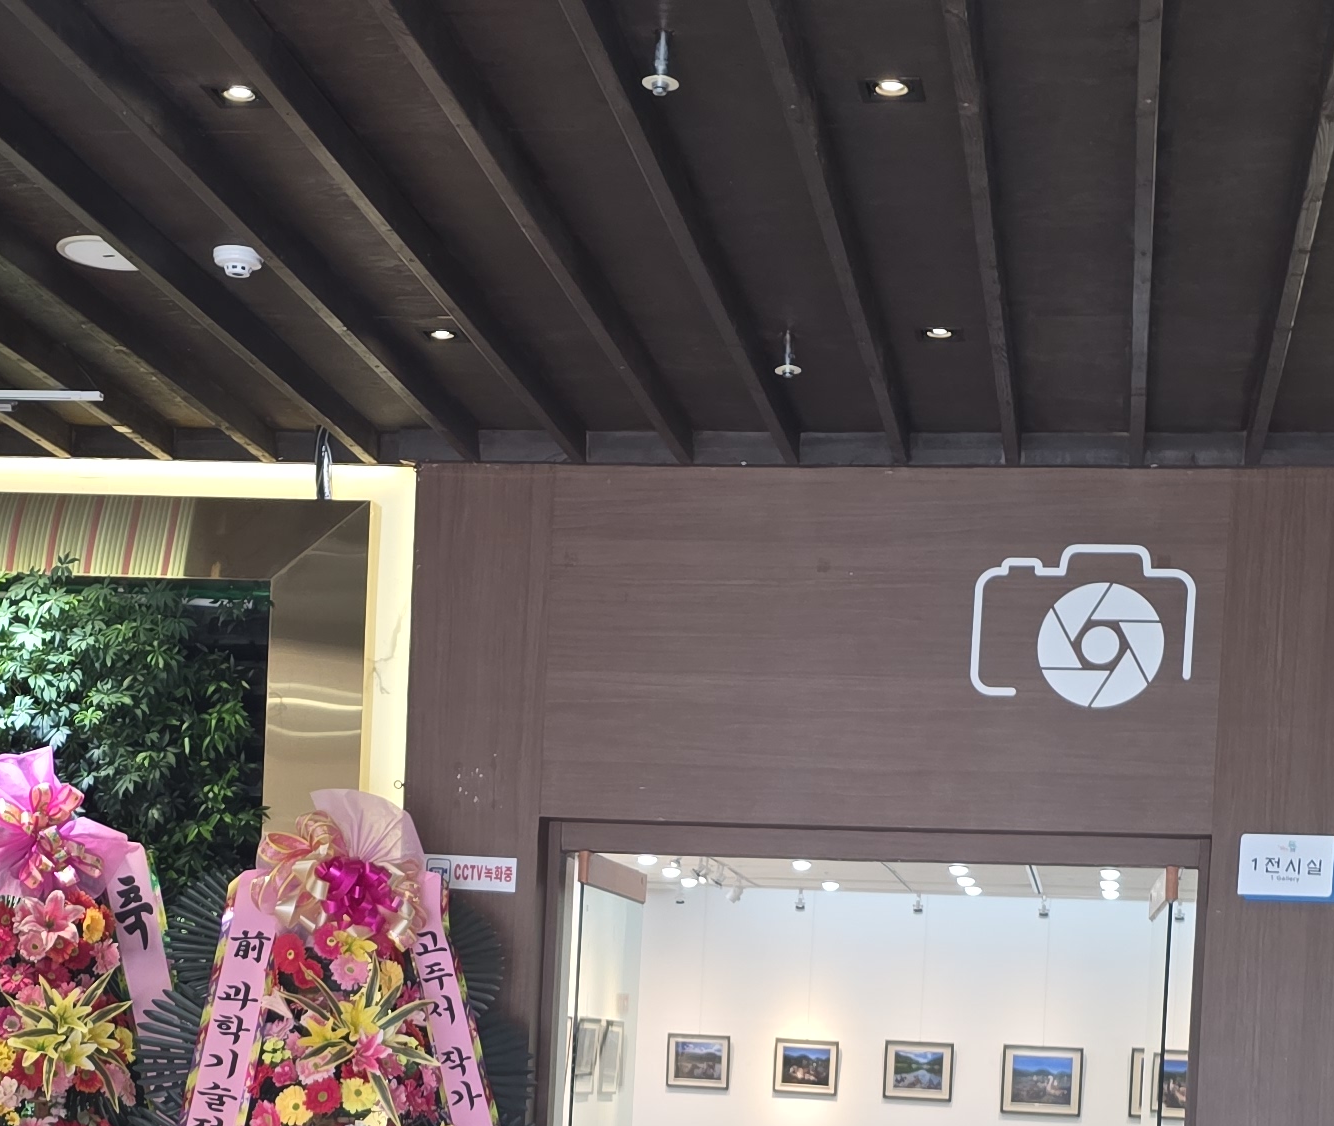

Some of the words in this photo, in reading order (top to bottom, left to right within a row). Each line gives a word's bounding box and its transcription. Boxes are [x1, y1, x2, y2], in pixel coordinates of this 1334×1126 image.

[453, 863, 513, 883] CCTV녹화중
[114, 875, 154, 951] 축
[230, 929, 272, 964] 前
[441, 1046, 483, 1111] 작가
